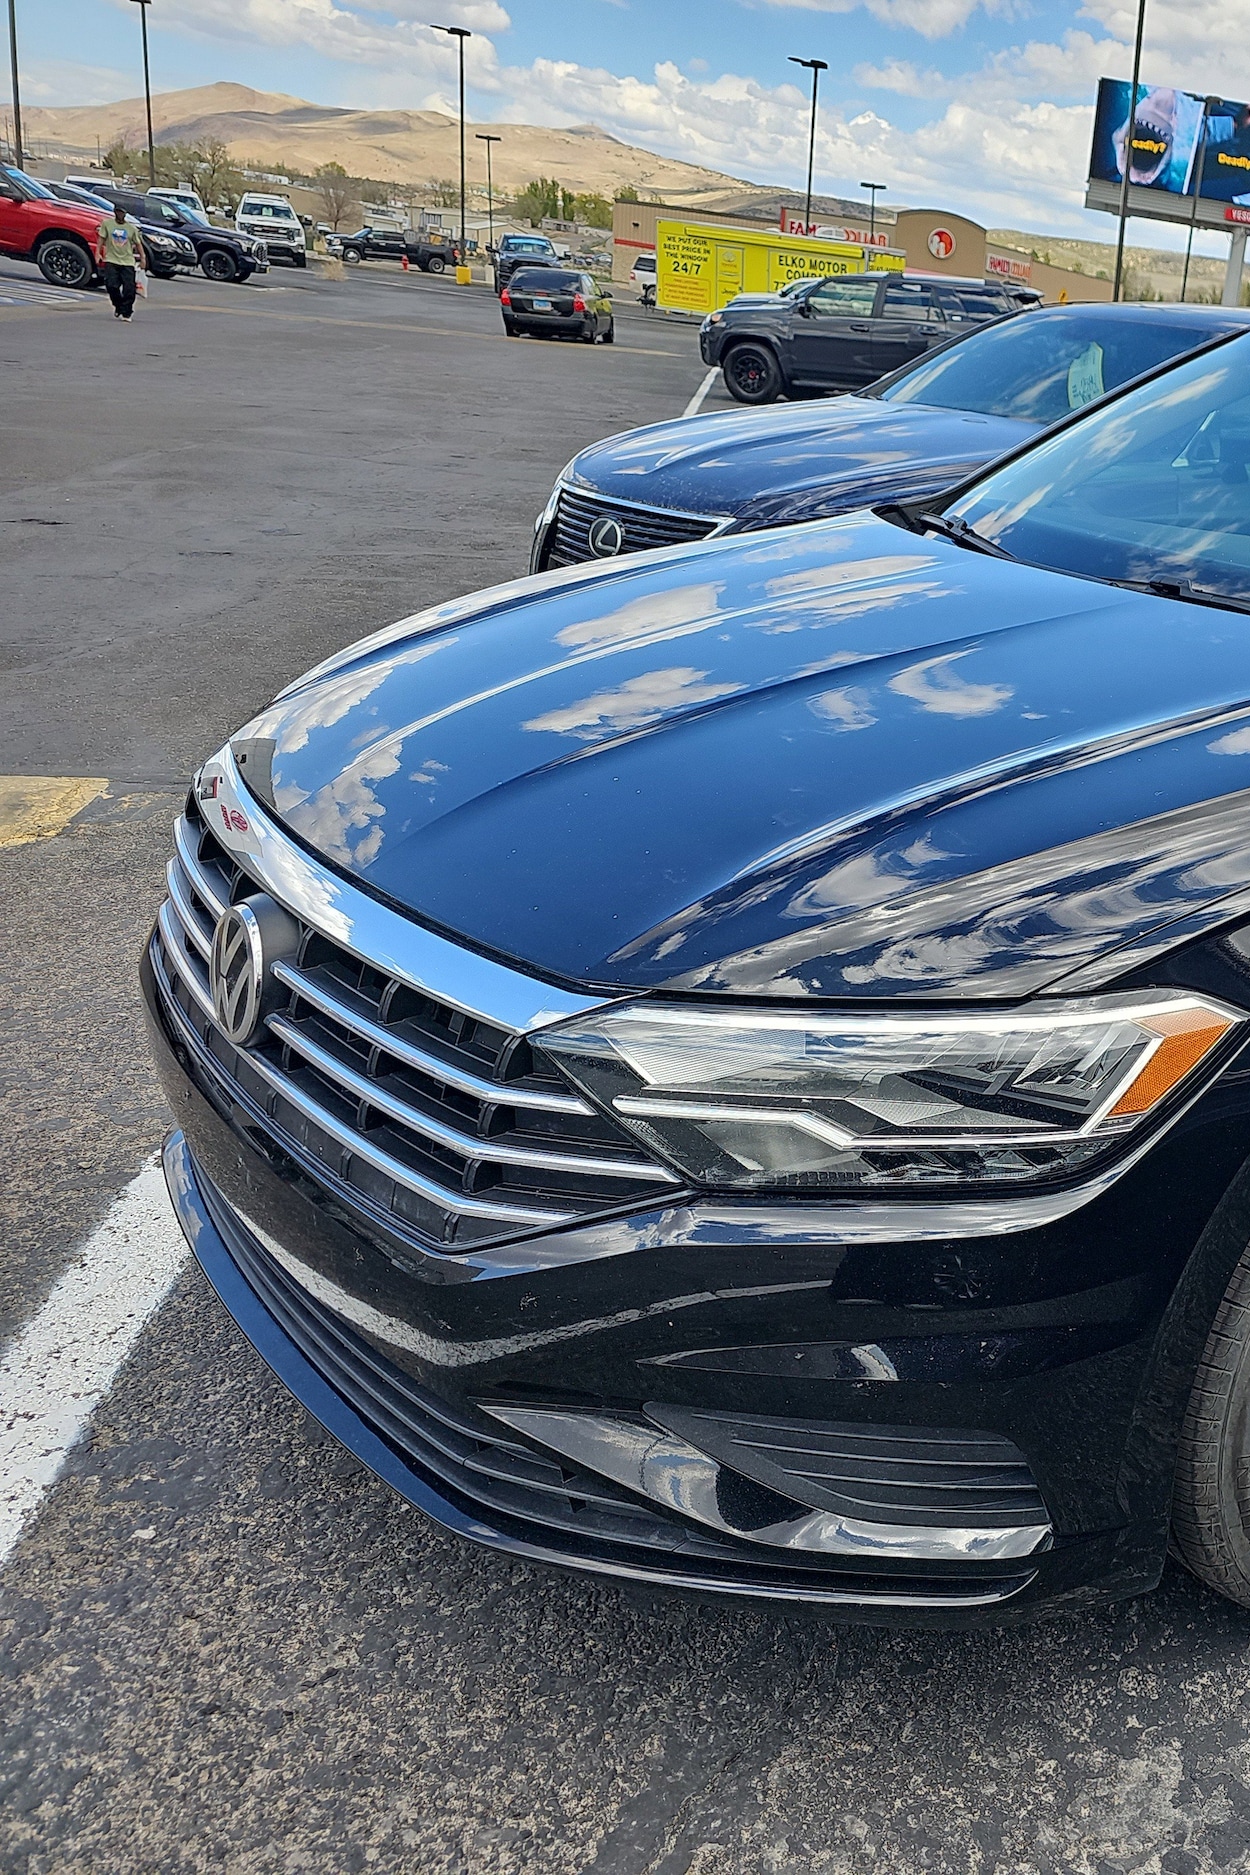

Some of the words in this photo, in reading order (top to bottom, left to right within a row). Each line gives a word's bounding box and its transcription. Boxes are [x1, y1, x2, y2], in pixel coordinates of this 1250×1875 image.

[672, 261, 701, 275] 24/7
[778, 255, 806, 268] ELKO
[809, 259, 848, 273] MOTOR
